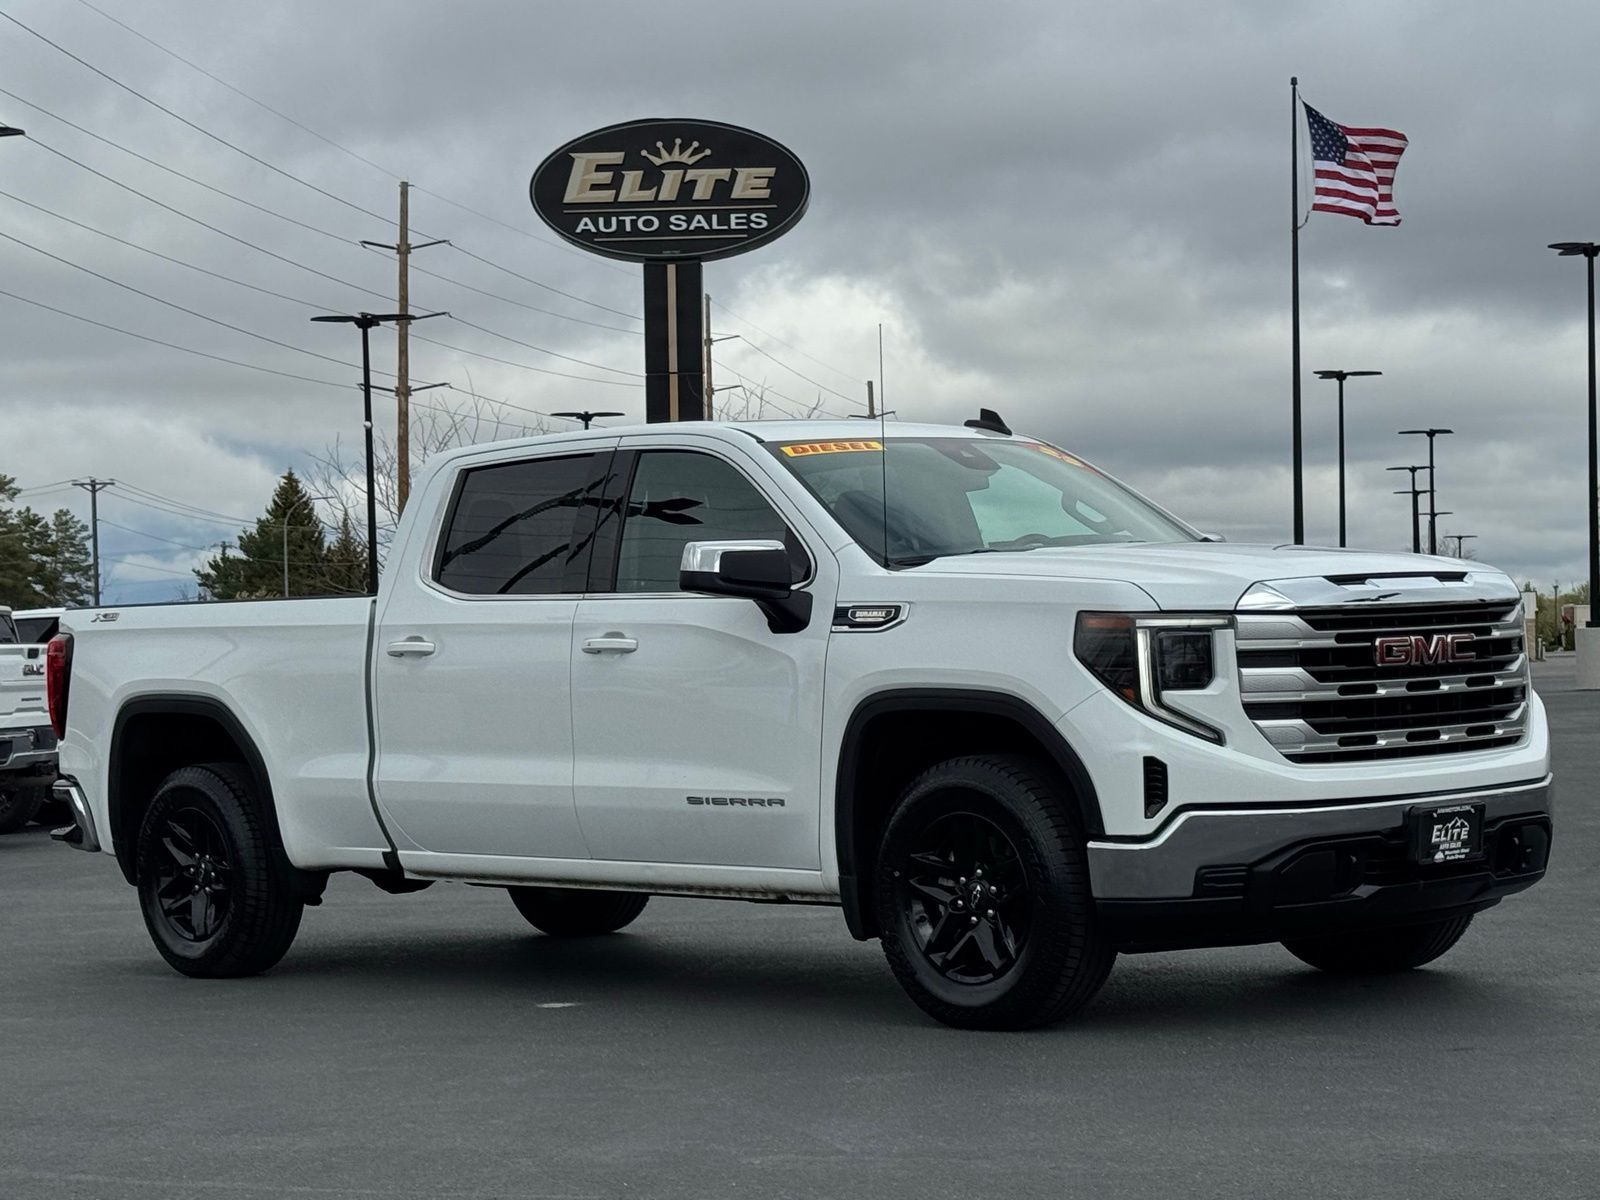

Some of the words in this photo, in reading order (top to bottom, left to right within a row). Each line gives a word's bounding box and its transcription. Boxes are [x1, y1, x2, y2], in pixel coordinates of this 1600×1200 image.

[562, 151, 777, 204] ELITE
[575, 215, 660, 234] AUTO
[669, 212, 769, 231] SALES
[790, 441, 879, 455] DIESEL
[1375, 633, 1477, 667] GMC
[686, 796, 786, 807] SIERRA
[1431, 824, 1470, 844] ELITE
